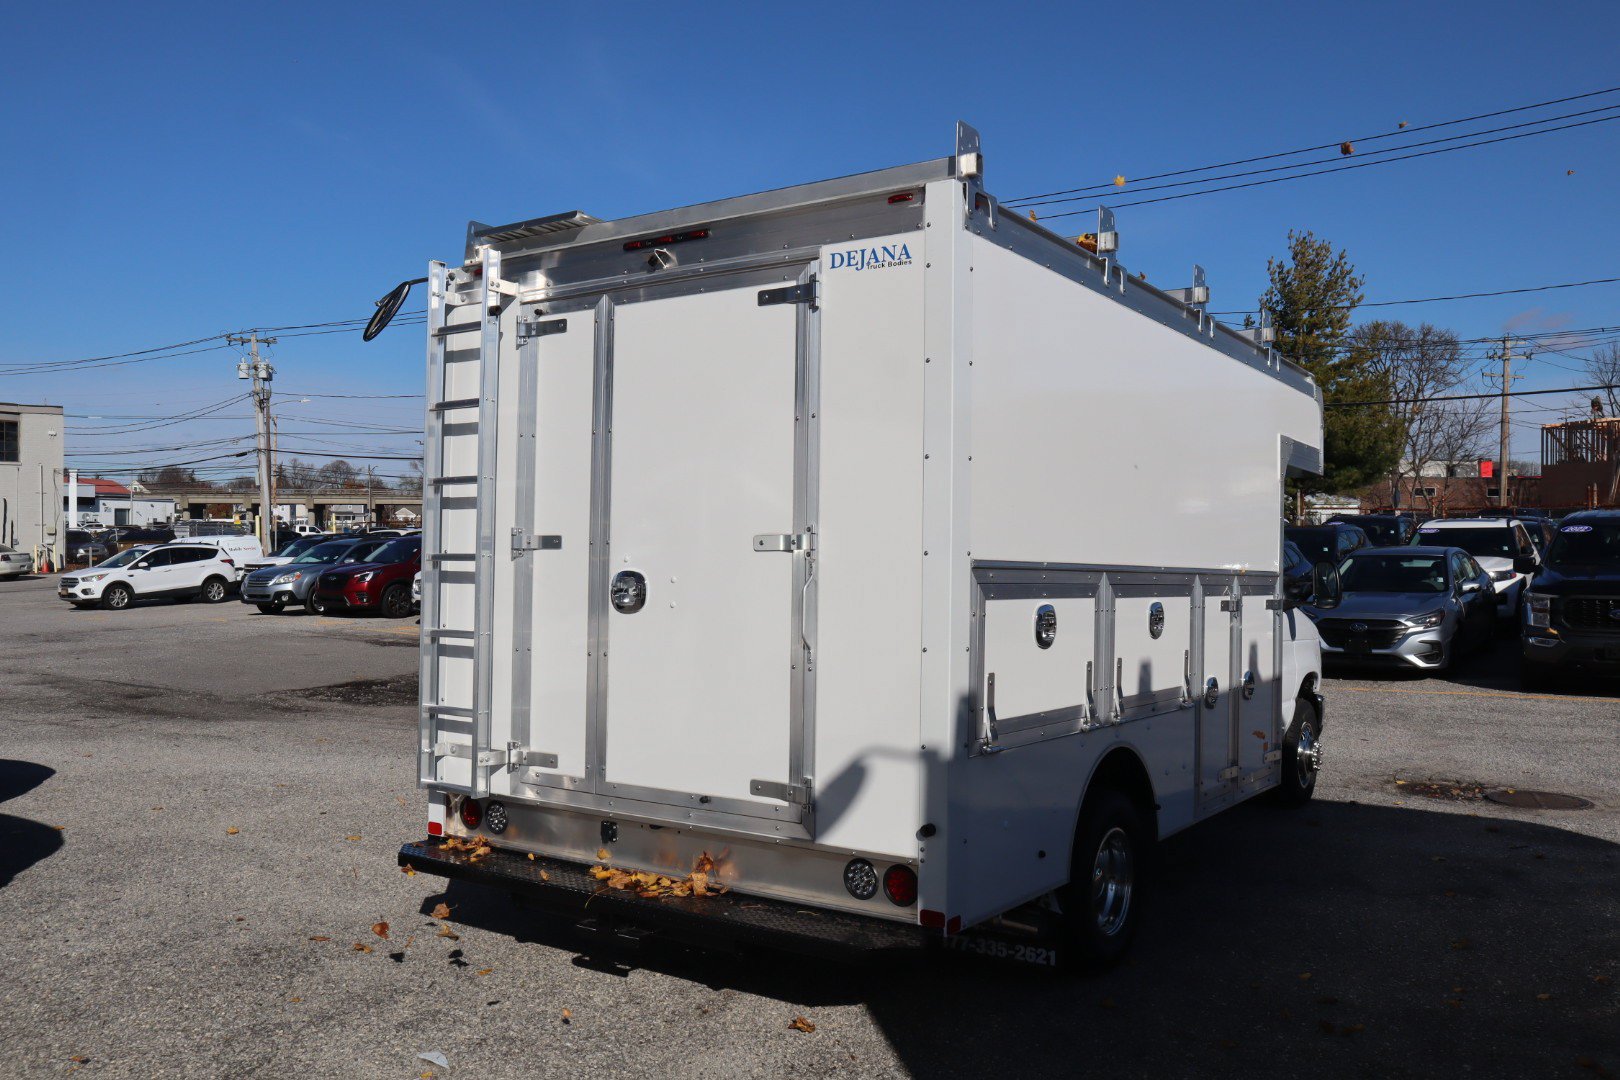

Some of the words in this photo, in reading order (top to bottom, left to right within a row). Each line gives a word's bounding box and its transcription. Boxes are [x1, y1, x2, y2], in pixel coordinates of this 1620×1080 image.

[830, 243, 912, 271] DEJANA
[867, 262, 885, 270] Truck
[887, 259, 912, 268] Bodies
